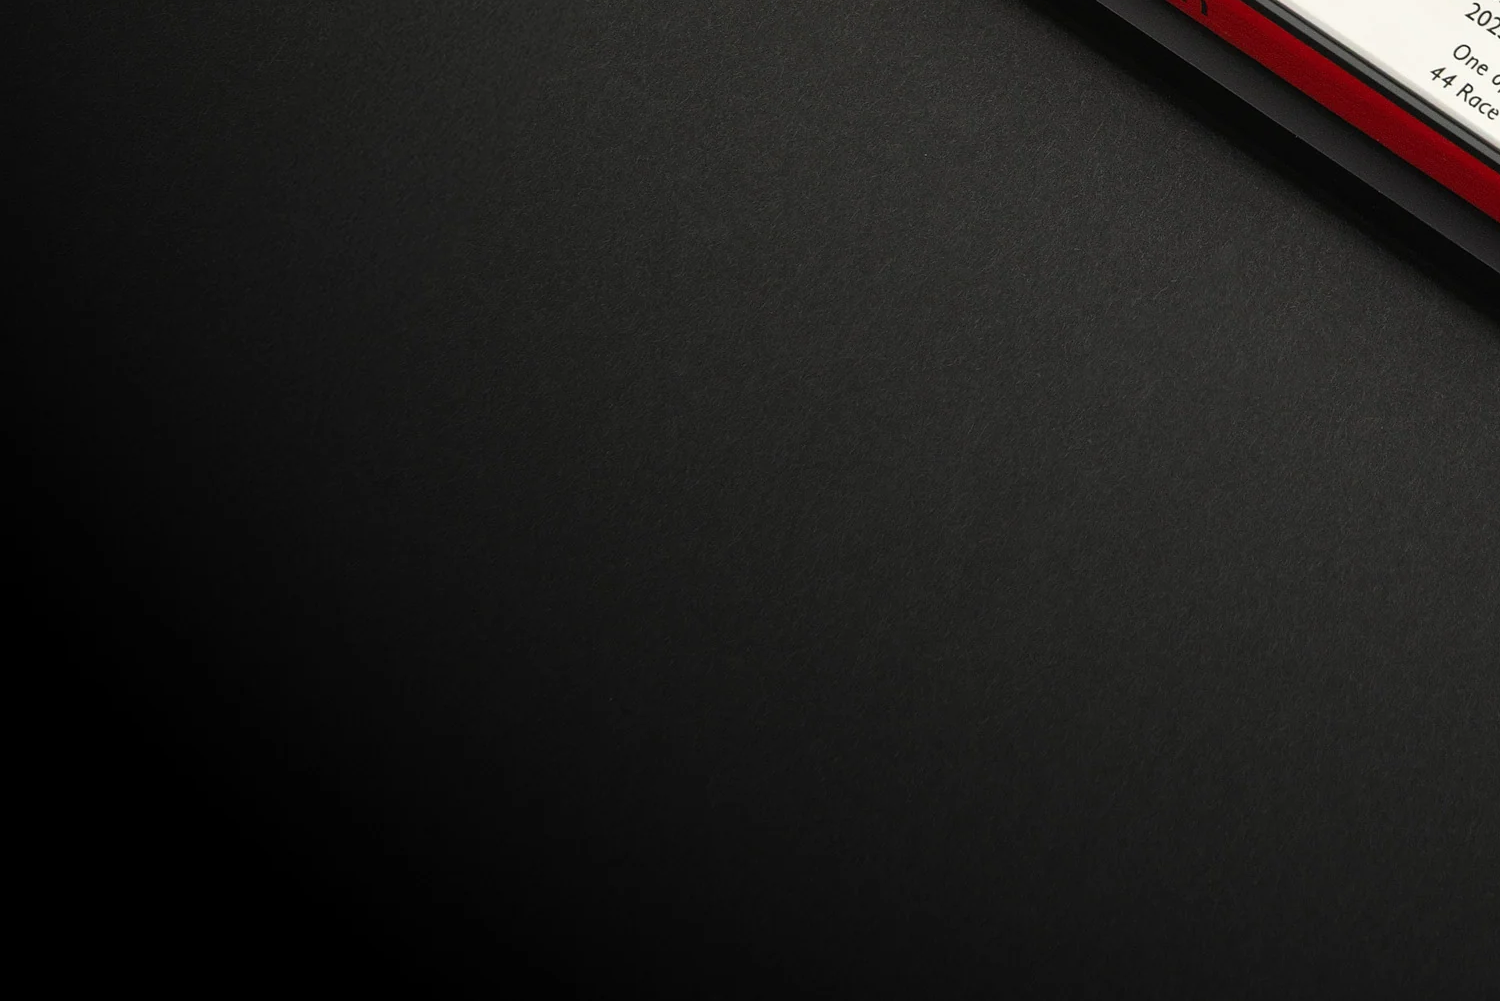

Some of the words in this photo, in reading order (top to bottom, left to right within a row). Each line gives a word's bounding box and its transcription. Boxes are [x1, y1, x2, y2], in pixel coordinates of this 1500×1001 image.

[1452, 43, 1490, 77] One
[1429, 65, 1458, 90] 44
[1455, 82, 1500, 121] Race
